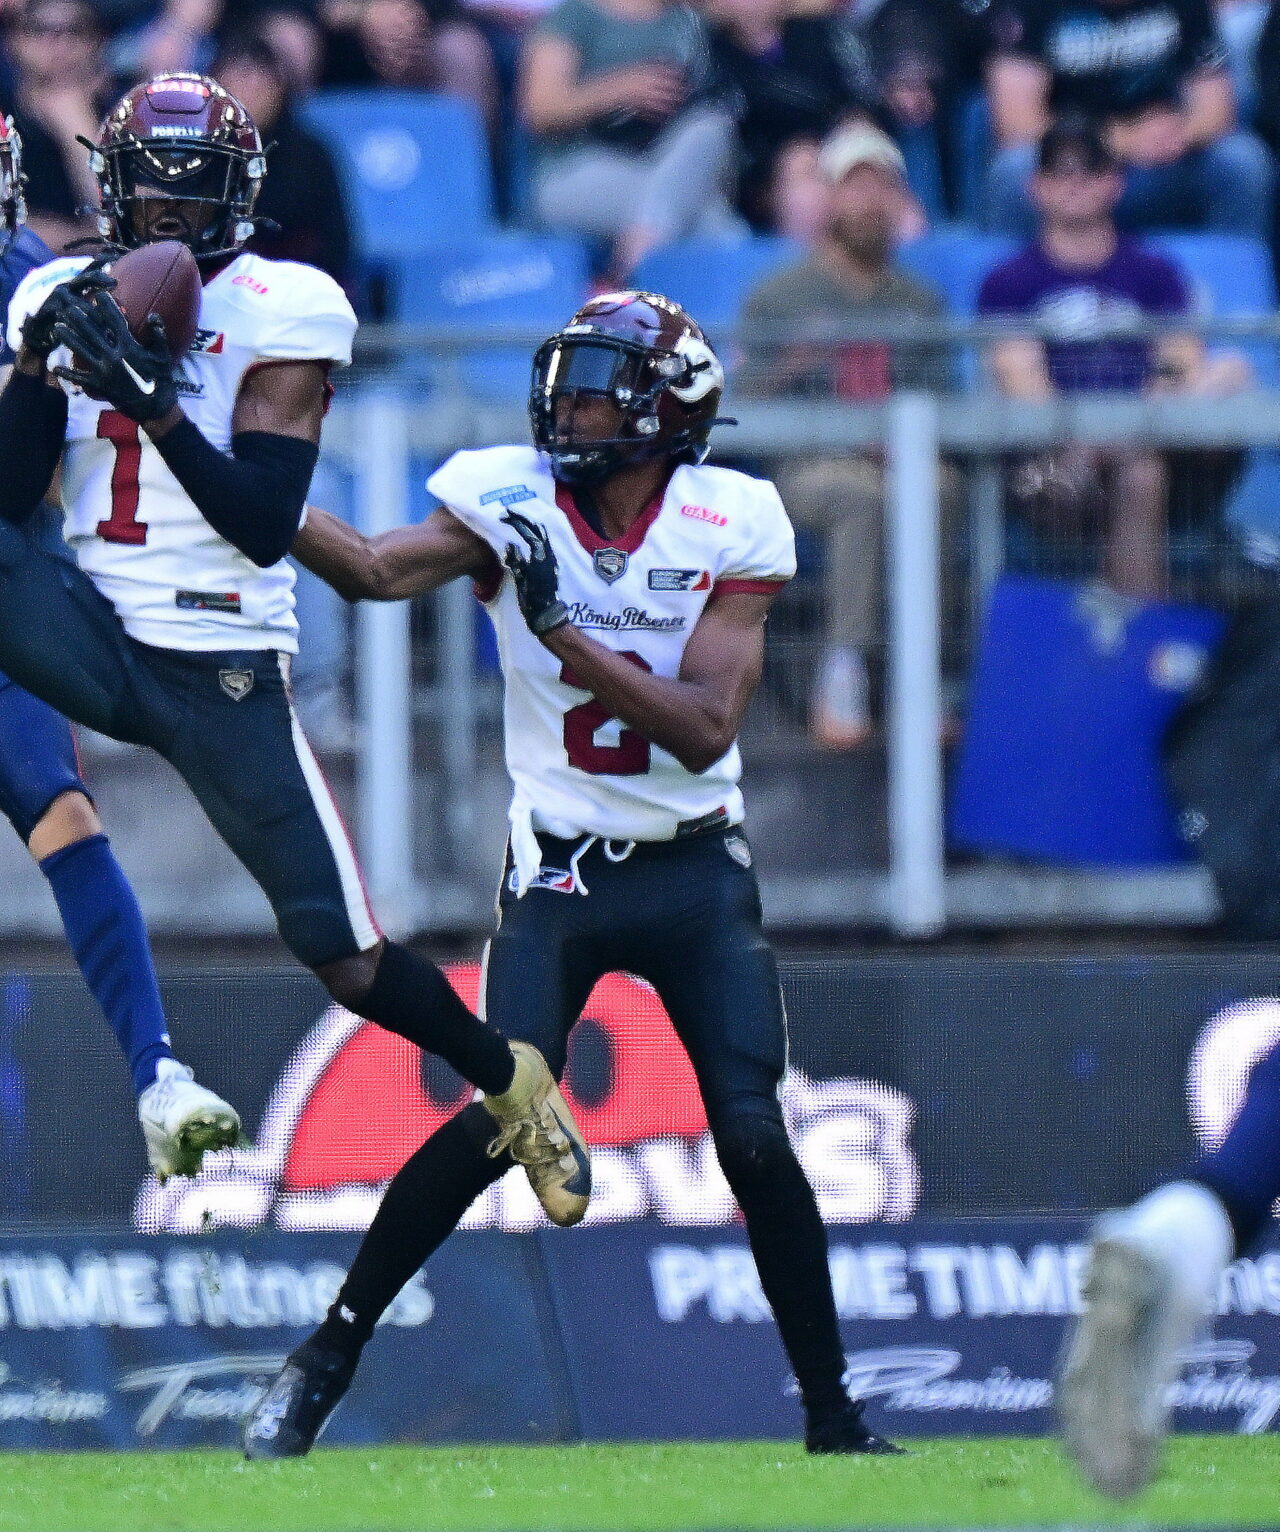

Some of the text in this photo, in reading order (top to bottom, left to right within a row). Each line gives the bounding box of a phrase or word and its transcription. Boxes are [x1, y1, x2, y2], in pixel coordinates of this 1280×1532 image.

[97, 409, 148, 545] 1
[570, 603, 685, 631] König Pilsener
